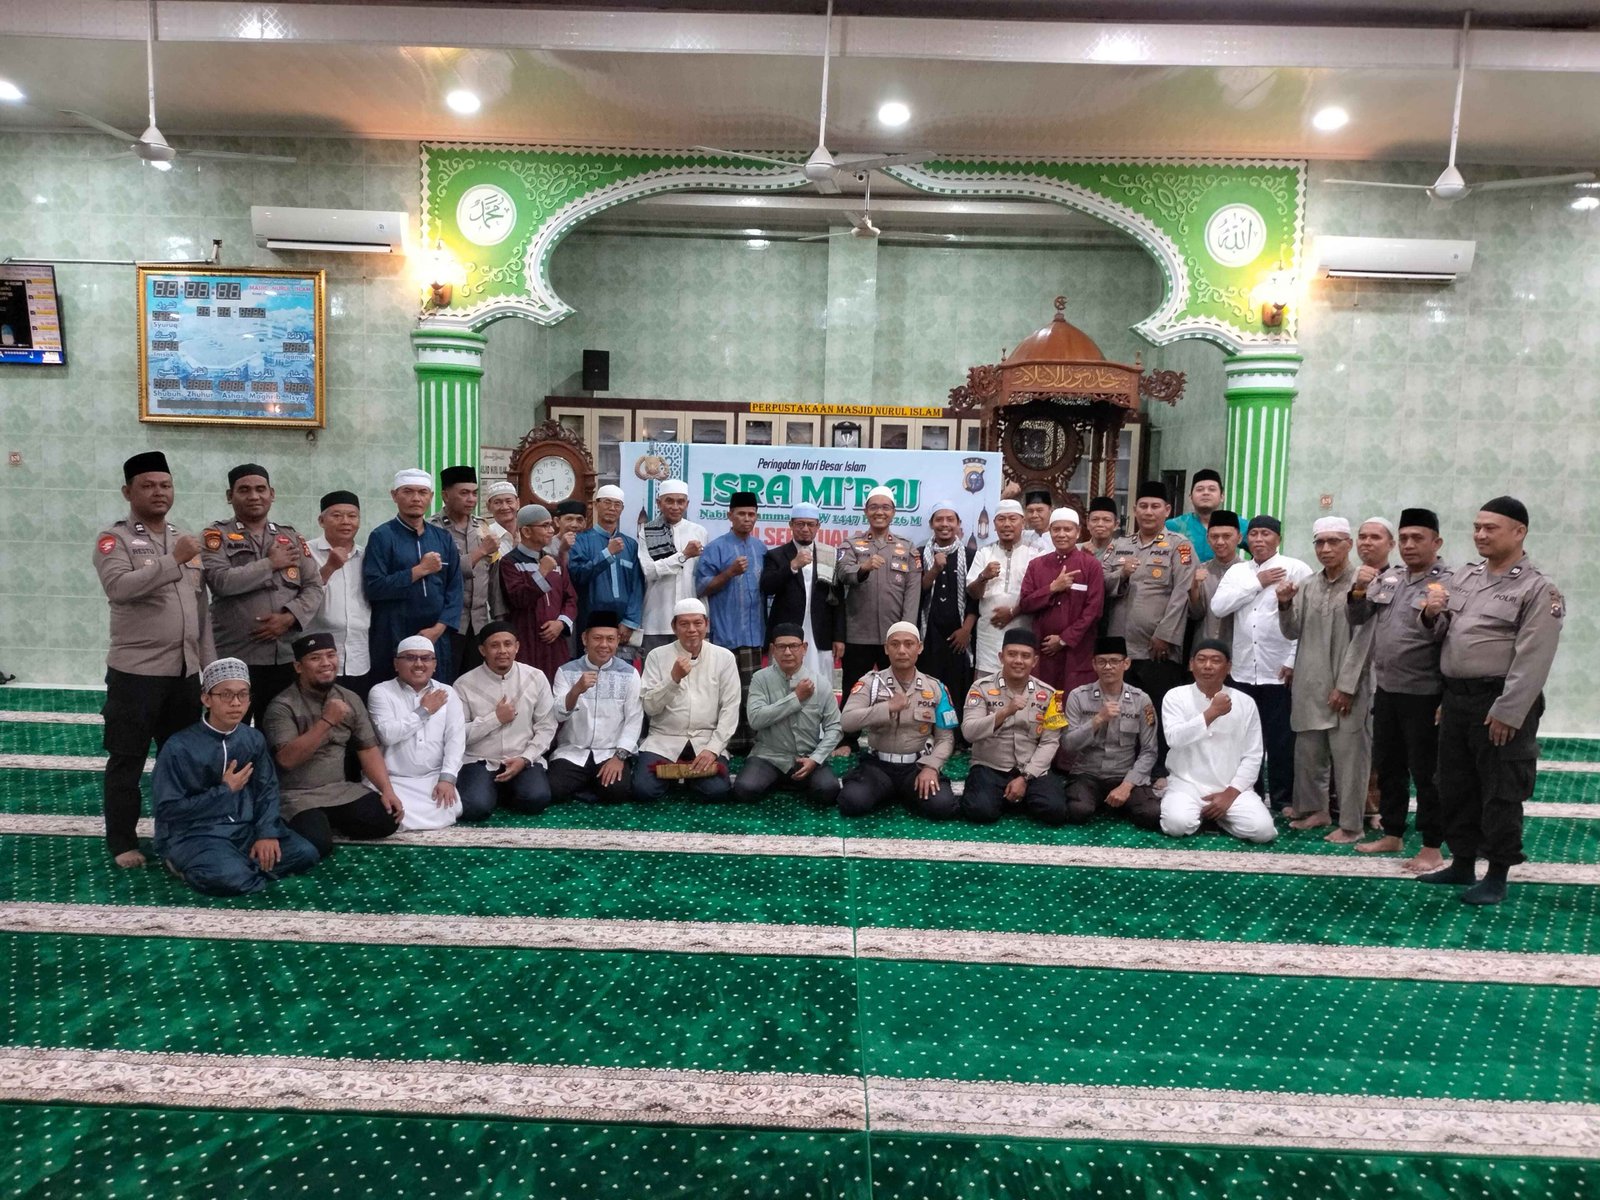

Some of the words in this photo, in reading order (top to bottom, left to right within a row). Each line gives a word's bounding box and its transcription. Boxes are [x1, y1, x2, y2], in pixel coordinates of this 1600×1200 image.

[752, 403, 834, 414] PERPUSTAKAAN
[836, 405, 873, 415] MASJID
[875, 407, 908, 416] NURUL
[910, 408, 940, 417] ISLAM
[757, 457, 800, 472] Peringatan
[801, 459, 820, 471] Hari
[820, 460, 844, 472] Besar
[844, 461, 867, 472] Islam
[701, 472, 793, 508] ISRA
[801, 475, 922, 512] MI'RAJ
[700, 509, 728, 521] Nabi
[832, 513, 862, 526] 1447
